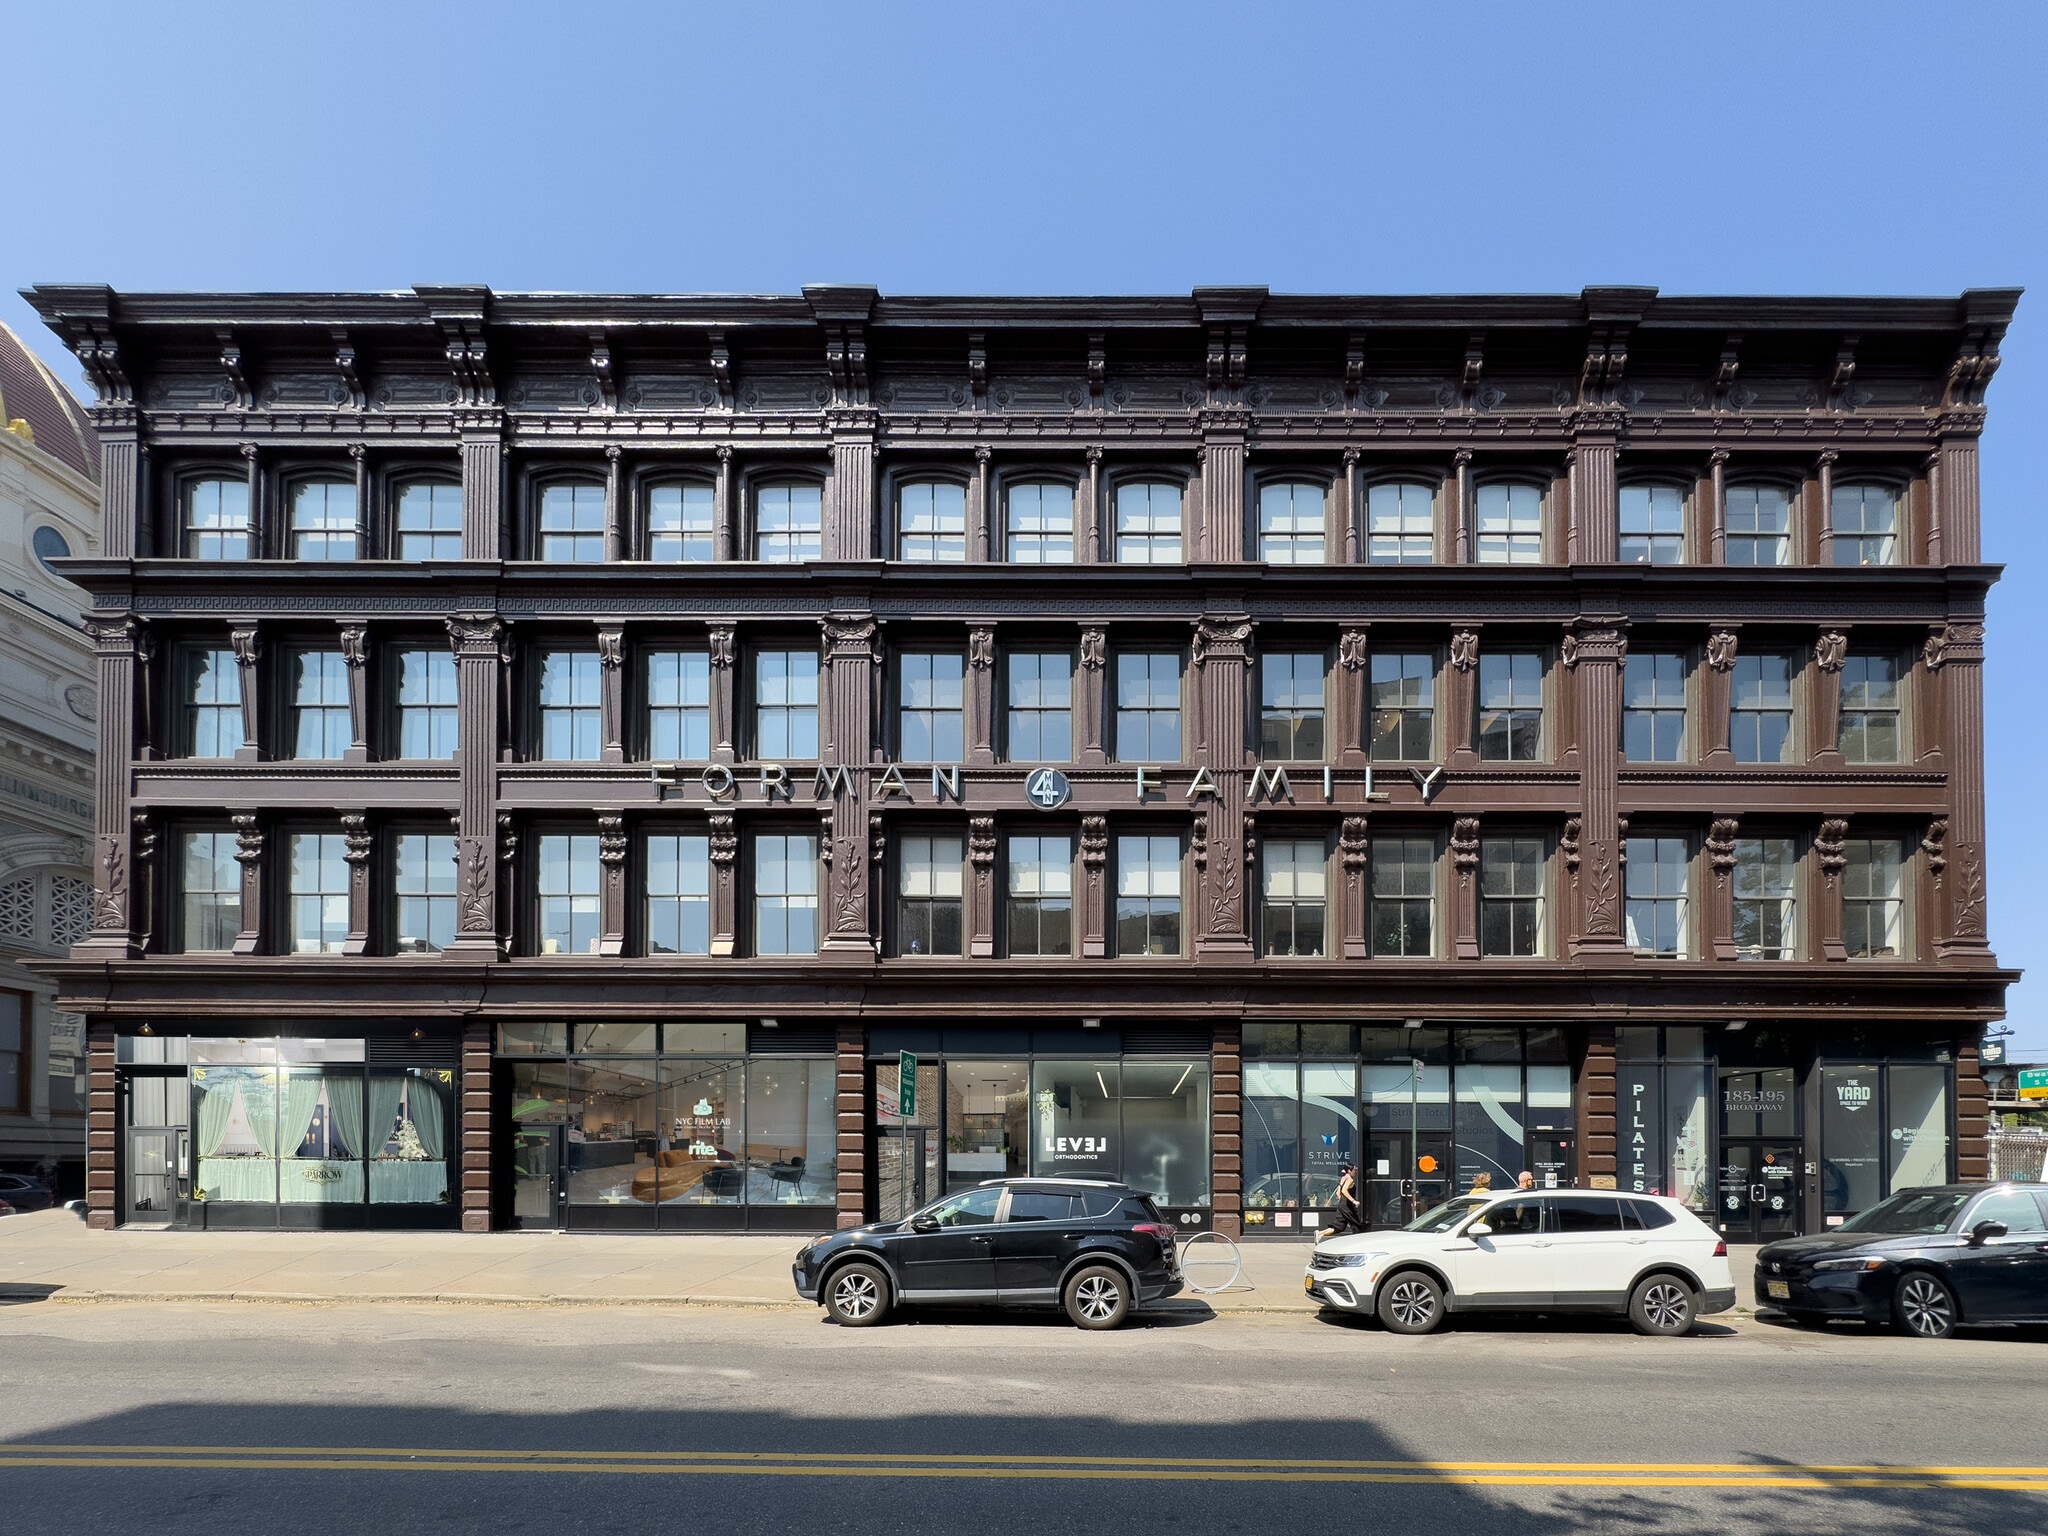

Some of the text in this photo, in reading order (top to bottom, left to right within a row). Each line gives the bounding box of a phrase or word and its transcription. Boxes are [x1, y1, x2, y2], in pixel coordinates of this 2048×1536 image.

[652, 763, 958, 798] FORMAN
[1137, 765, 1444, 798] FAMILY
[1724, 1091, 1786, 1102] 185-195
[1836, 1086, 1871, 1100] YARD
[1456, 1126, 1494, 1135] Studios
[1632, 1084, 1645, 1192] PILATES
[688, 1140, 718, 1155] rite.
[1308, 1151, 1351, 1160] STRIVE
[302, 1170, 343, 1180] SPARROW
